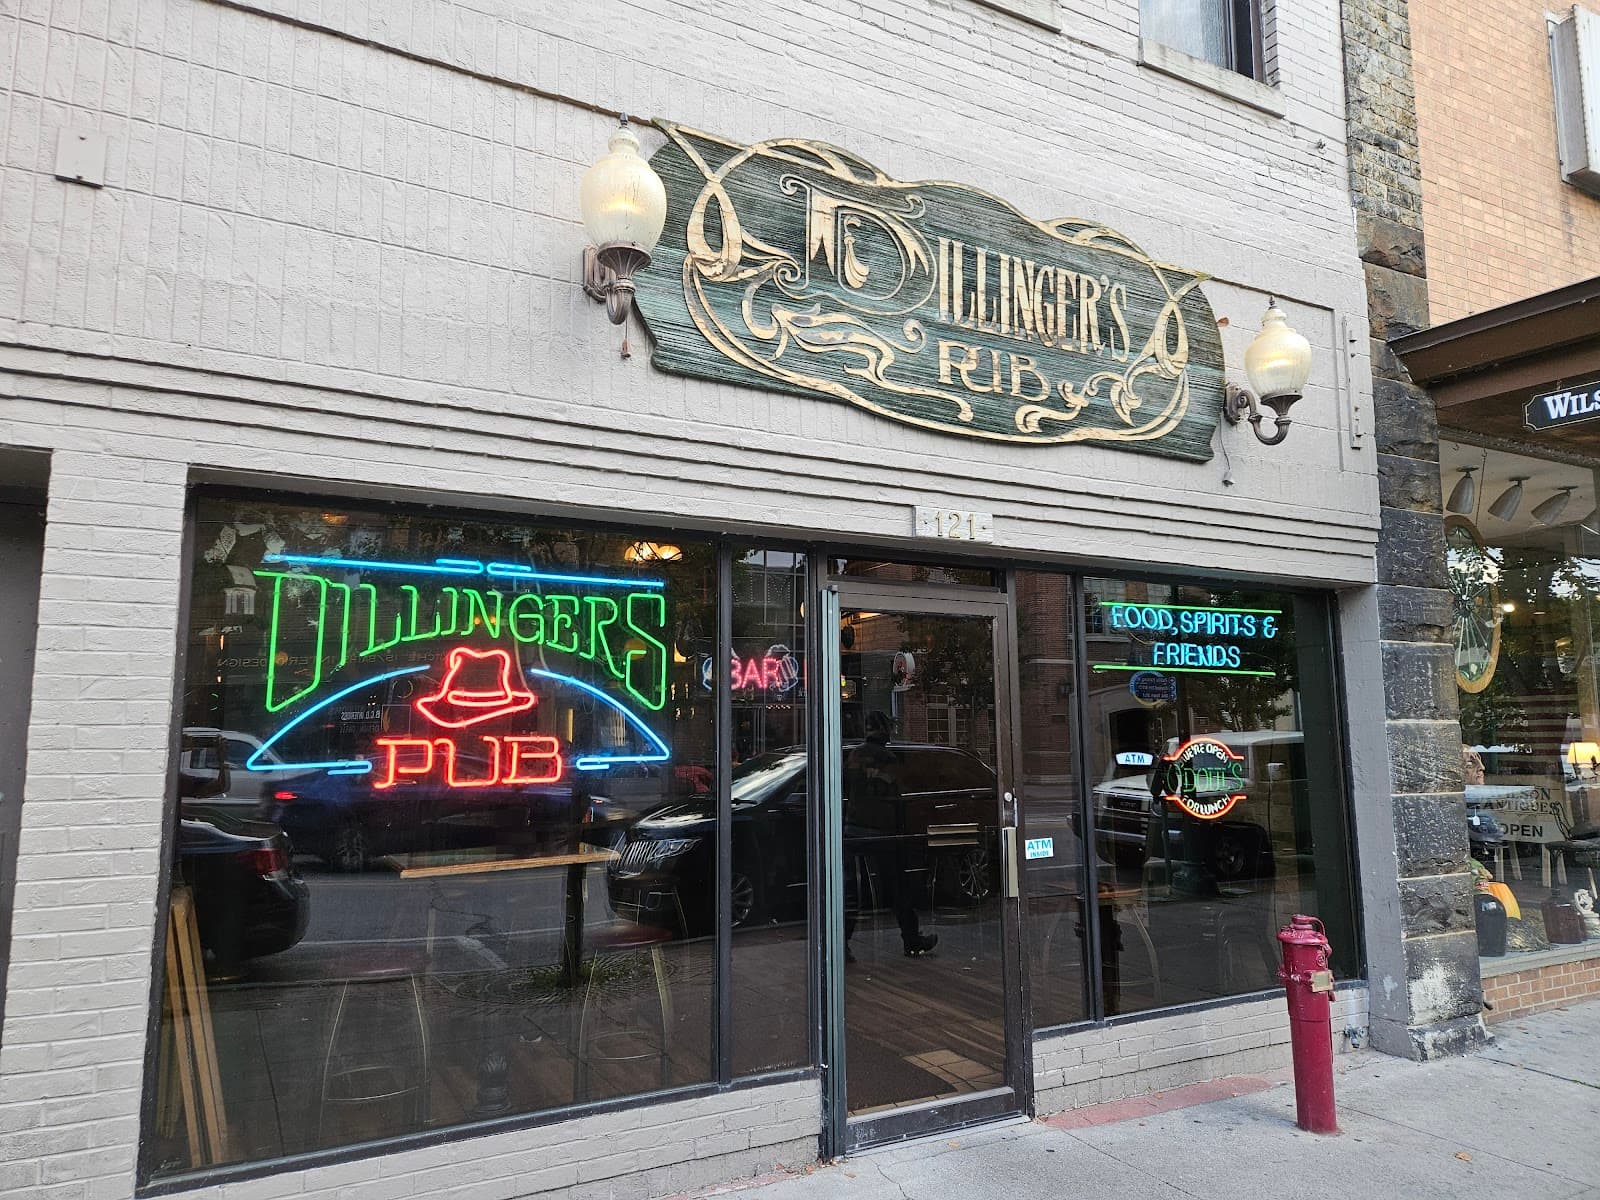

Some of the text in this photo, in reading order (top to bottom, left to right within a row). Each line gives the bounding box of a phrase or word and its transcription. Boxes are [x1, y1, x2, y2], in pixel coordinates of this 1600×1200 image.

[781, 174, 1129, 362] DILLINGER'S
[937, 340, 1051, 402] PUB
[935, 510, 977, 540] 121
[254, 570, 666, 711] DILLINGERS
[1263, 616, 1279, 639] &
[1153, 642, 1241, 668] FRIENDS
[731, 658, 781, 690] BAR
[373, 736, 563, 789] PUB
[1124, 754, 1145, 764] ATM
[1205, 743, 1229, 764] OPEN
[1027, 839, 1052, 850] ATM
